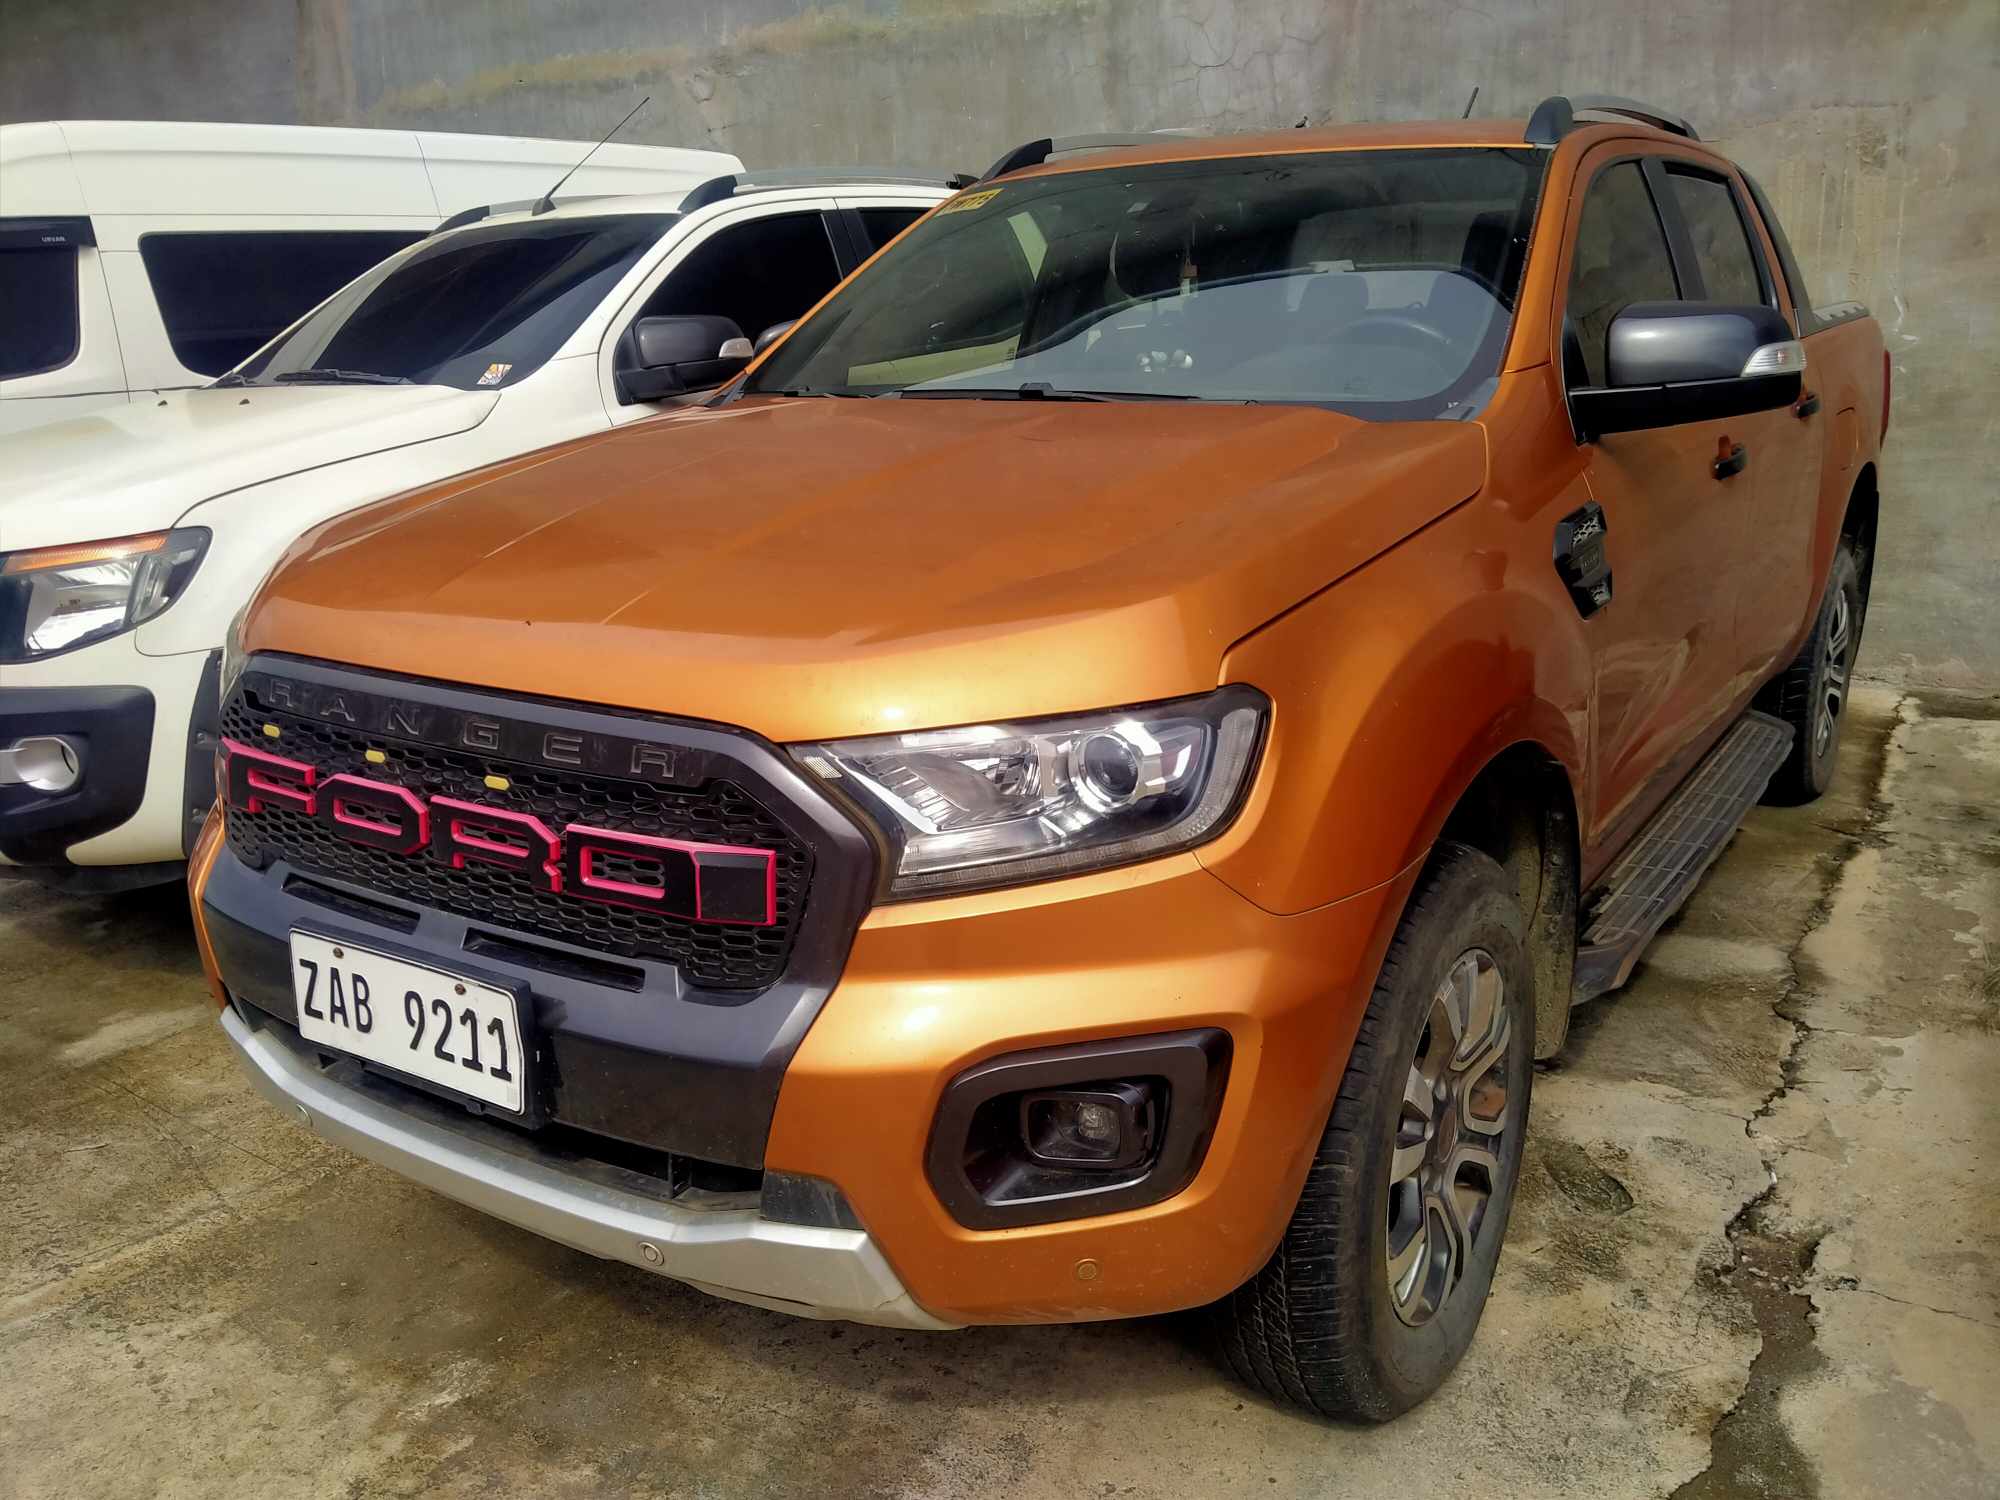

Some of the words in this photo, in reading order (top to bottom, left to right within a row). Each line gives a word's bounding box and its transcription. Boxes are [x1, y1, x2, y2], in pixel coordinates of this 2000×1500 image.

[268, 678, 677, 779] RANGER
[221, 736, 776, 926] FORD
[299, 958, 374, 1034] ZAB
[403, 990, 512, 1083] 9211
